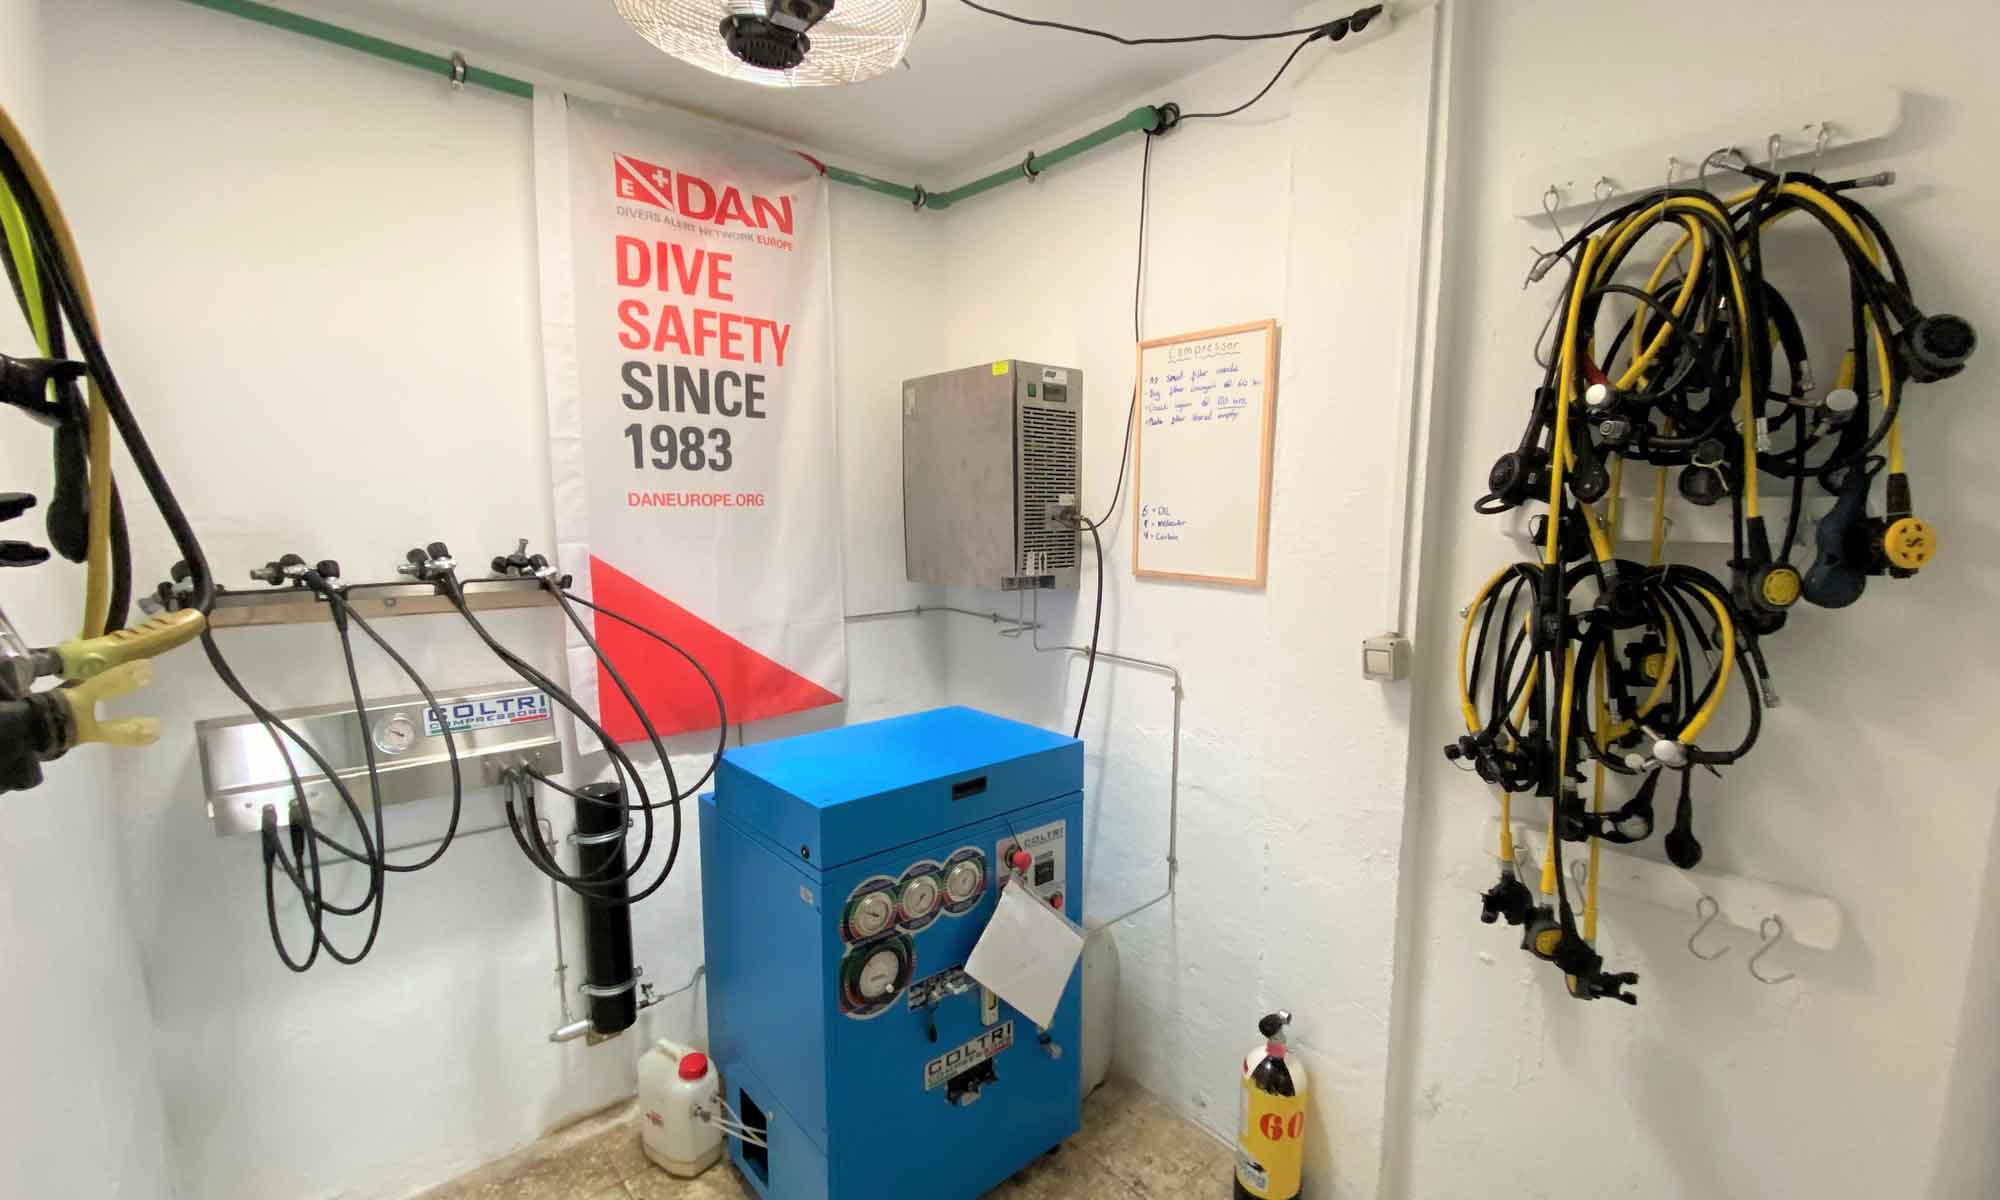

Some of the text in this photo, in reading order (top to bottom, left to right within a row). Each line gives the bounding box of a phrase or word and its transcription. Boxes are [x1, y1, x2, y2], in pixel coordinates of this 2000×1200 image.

[616, 204, 793, 252] DIVERS ALERT NETWORK EUROPE
[621, 172, 793, 236] E DAN
[615, 234, 734, 302] DIVE
[617, 299, 790, 367] SAFETY
[1167, 341, 1240, 361] Compressor
[620, 360, 766, 419] SINCE
[624, 423, 733, 472] 1983
[627, 492, 765, 508] DANEUROPE.ORG
[928, 1022, 1012, 1076] COLTRI
[1259, 1111, 1304, 1142] 60
